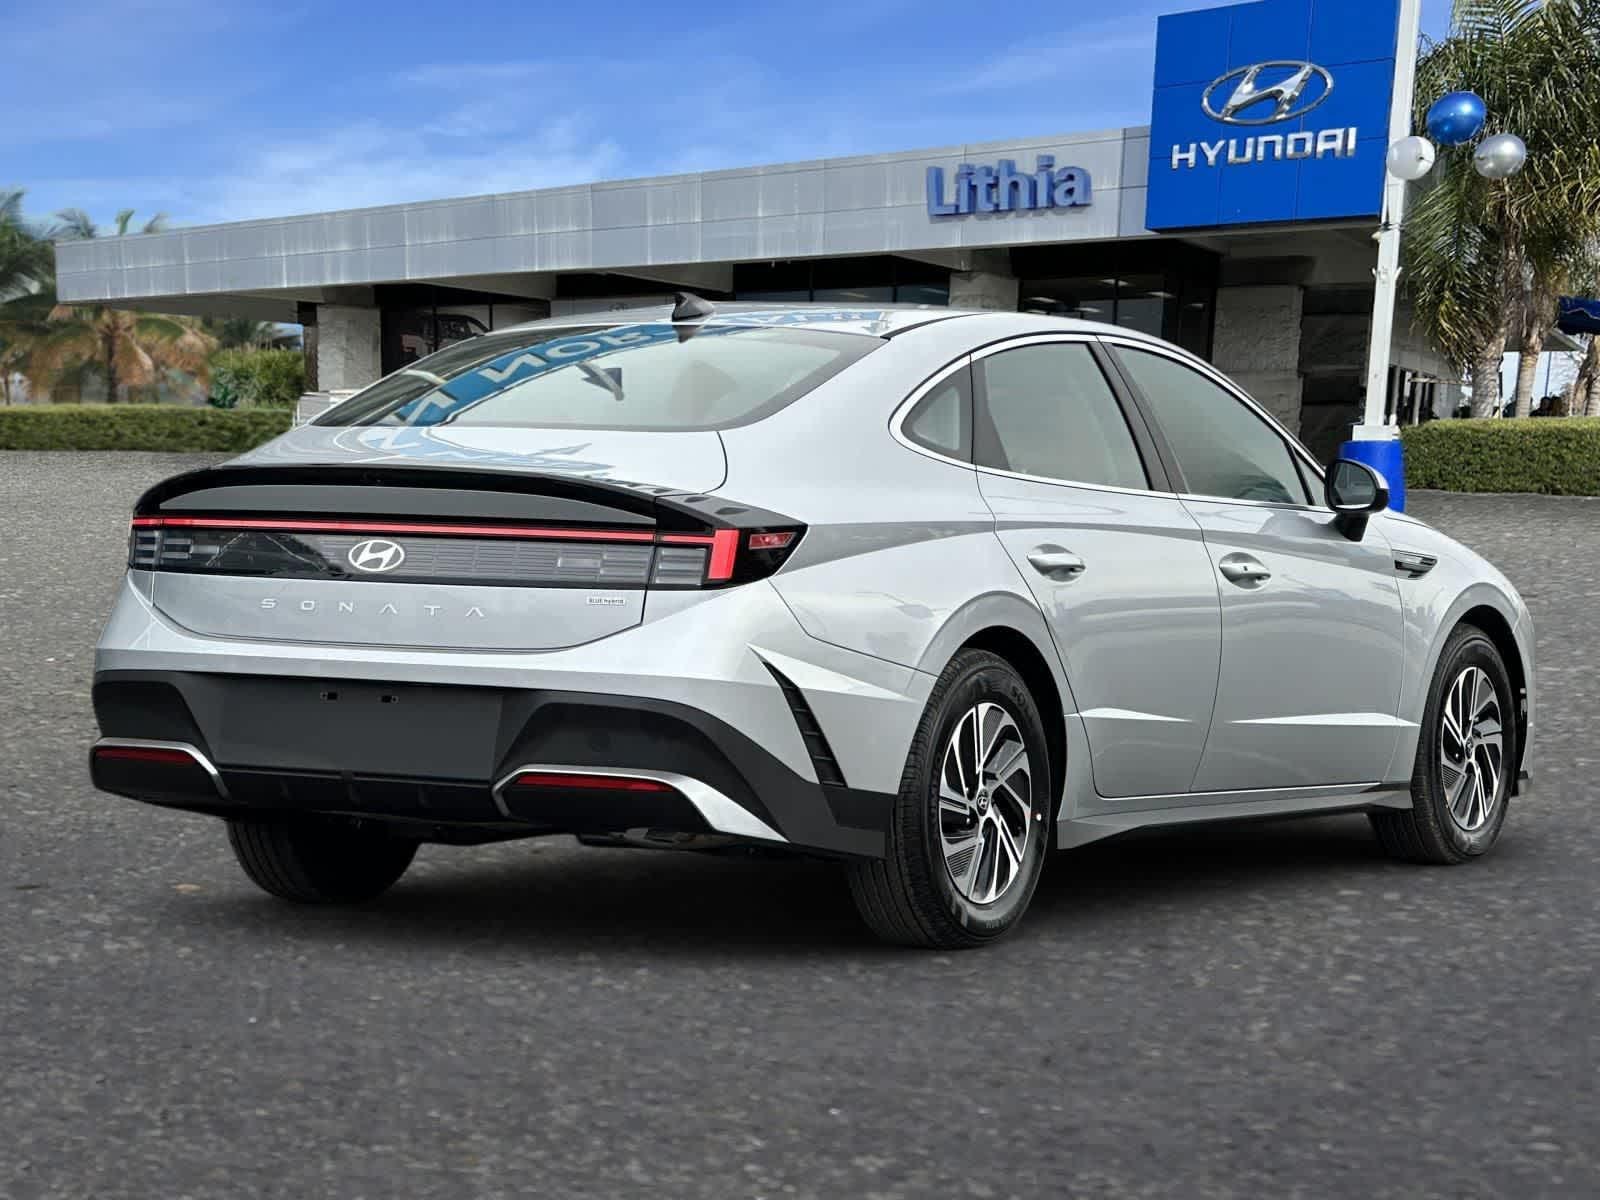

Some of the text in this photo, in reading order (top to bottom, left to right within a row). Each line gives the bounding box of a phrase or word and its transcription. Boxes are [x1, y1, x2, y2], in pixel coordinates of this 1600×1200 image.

[1171, 127, 1357, 169] HYUNDAI
[927, 154, 1092, 217] Lithia
[260, 598, 485, 618] SONATA
